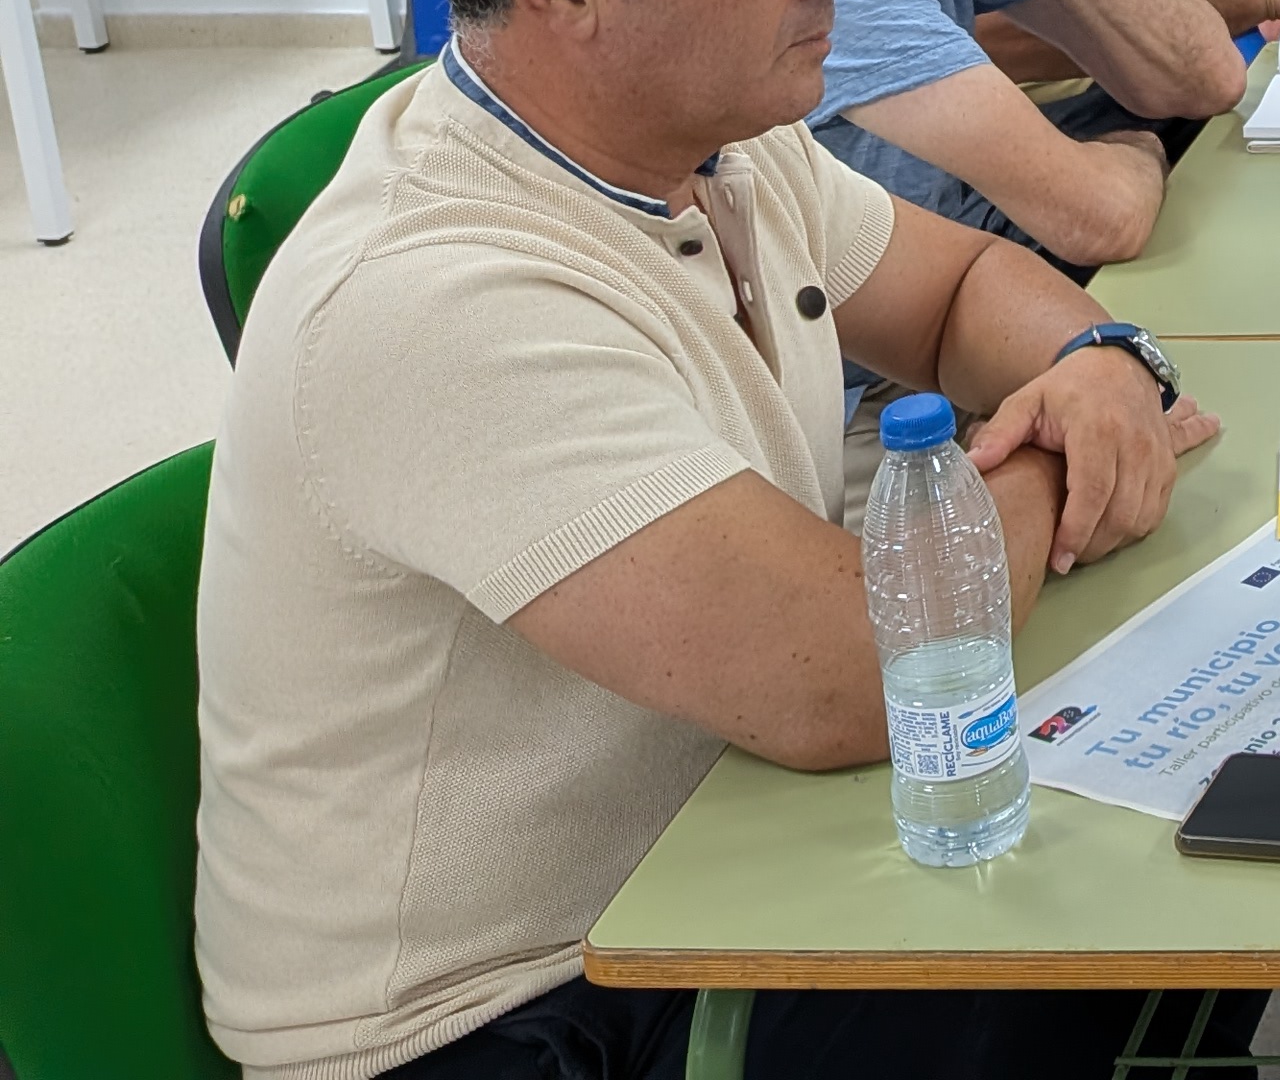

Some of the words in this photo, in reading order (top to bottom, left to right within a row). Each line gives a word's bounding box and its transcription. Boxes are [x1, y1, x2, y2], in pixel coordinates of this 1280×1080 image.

[1084, 728, 1142, 755] Tu
[1123, 743, 1172, 769] tu
[1166, 703, 1231, 739] río,
[1216, 671, 1262, 695] tu
[1158, 748, 1198, 776] Taller
[1197, 689, 1272, 749] participativo
[1244, 730, 1277, 756] nio
